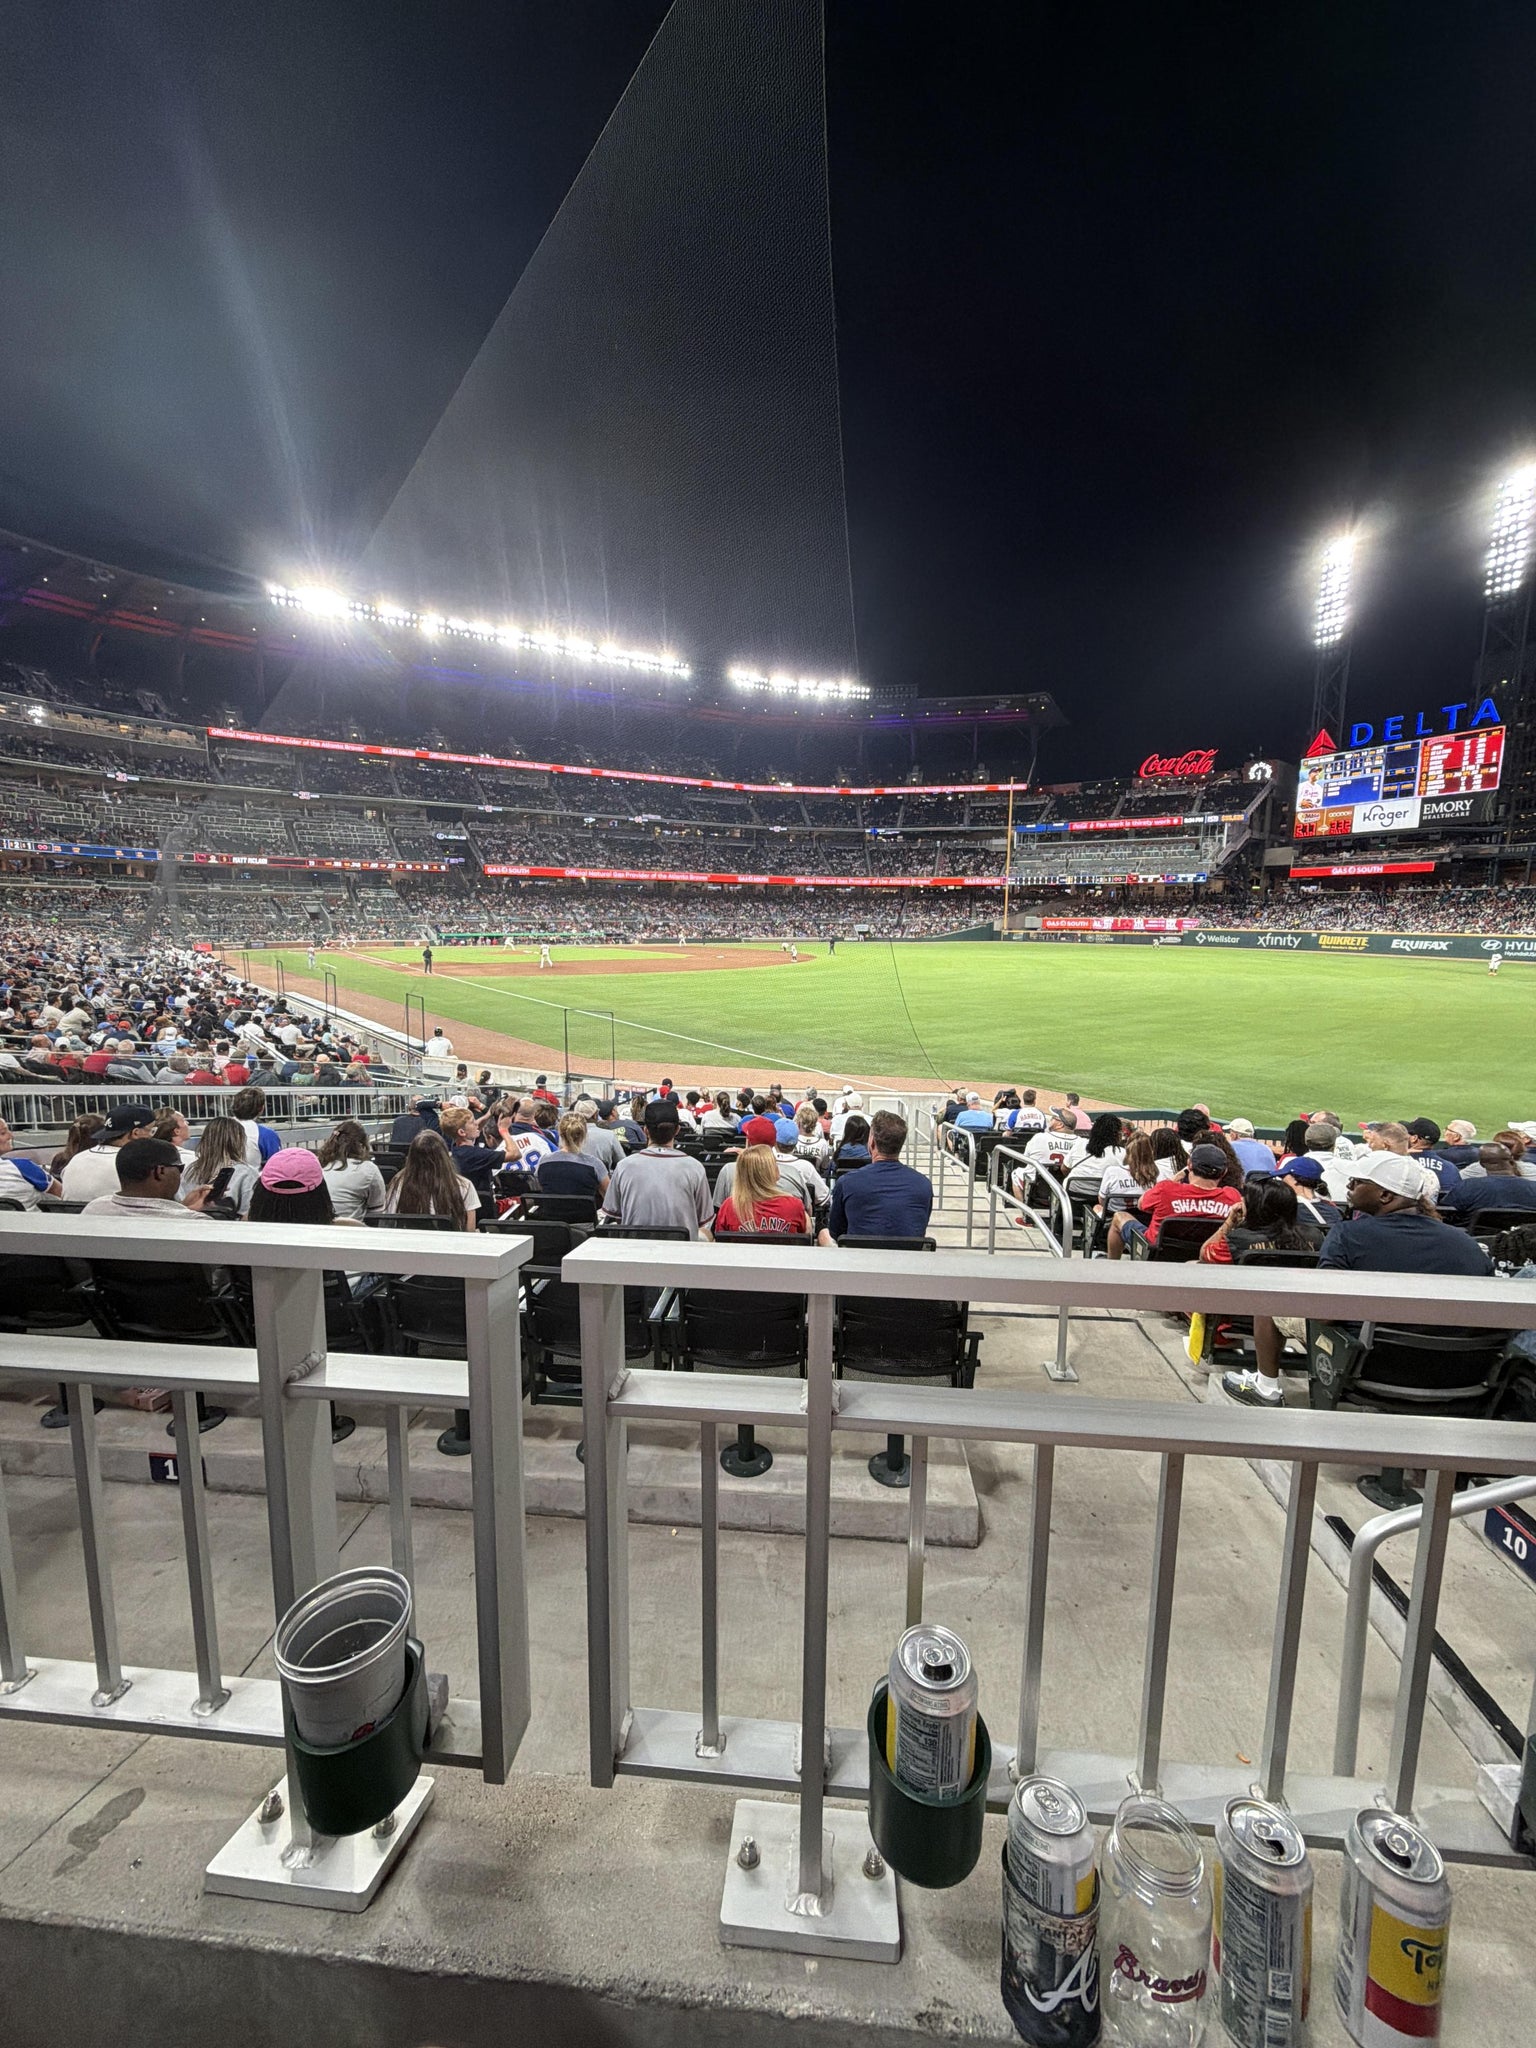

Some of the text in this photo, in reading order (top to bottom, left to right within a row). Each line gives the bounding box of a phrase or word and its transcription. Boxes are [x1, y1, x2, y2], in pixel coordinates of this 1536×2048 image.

[1350, 698, 1501, 747] DELTA
[1139, 749, 1219, 778] Coca-Cola
[1423, 799, 1474, 815] EMORY
[1363, 805, 1410, 828] Kroger
[1422, 811, 1470, 820] HEALTHCARE
[1356, 866, 1383, 874] SOUTH
[1207, 934, 1240, 944] Wellstar
[1257, 933, 1302, 948] xfinity
[1319, 935, 1368, 946] QUIKRETE
[1391, 939, 1449, 951] EQUIFAX
[1171, 1199, 1232, 1216] SWANSON
[1502, 1526, 1527, 1560] 10
[1114, 1944, 1207, 2003] Braves
